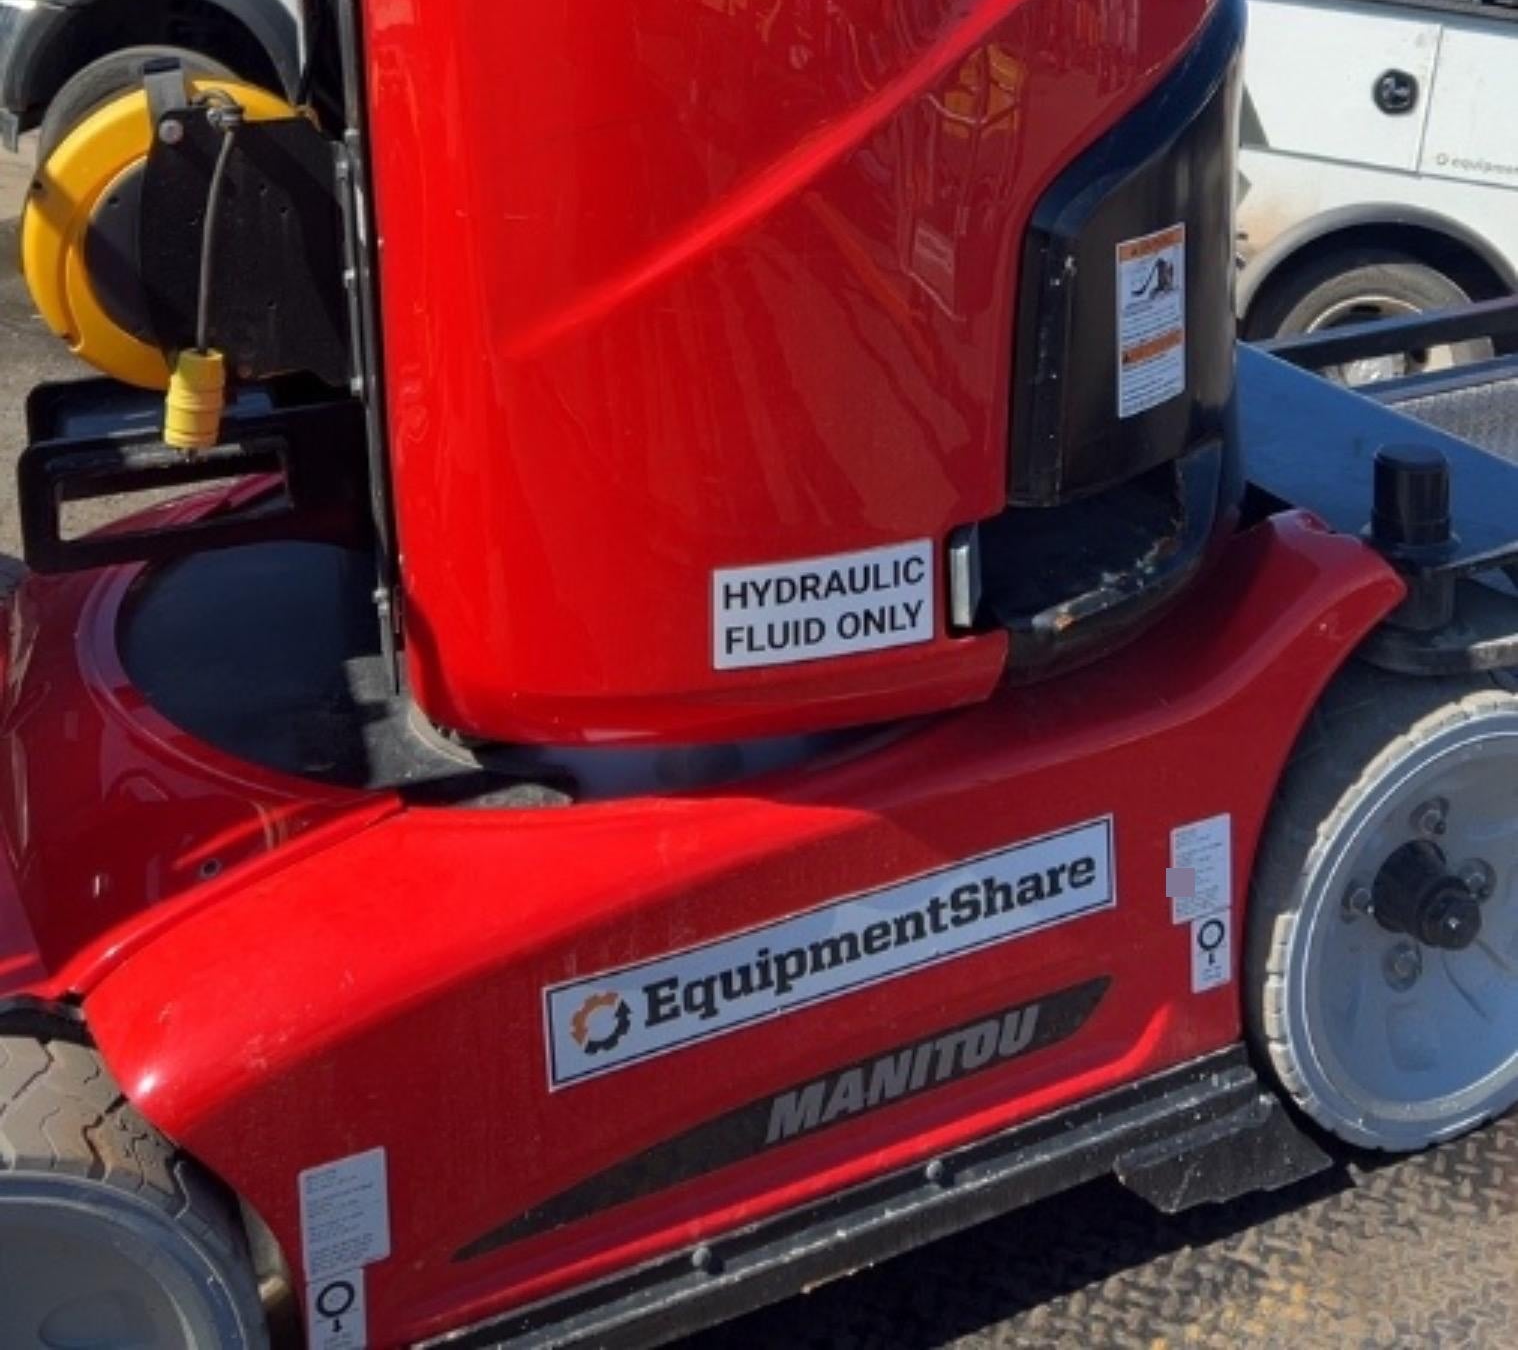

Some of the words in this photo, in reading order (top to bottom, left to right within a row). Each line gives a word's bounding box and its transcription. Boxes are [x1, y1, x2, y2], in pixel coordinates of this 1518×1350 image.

[722, 555, 925, 610] HYDRAULIC
[725, 617, 826, 654] FLUID
[836, 600, 924, 640] ONLY
[642, 854, 1096, 1028] EquipmentShare
[764, 1004, 1041, 1145] MANITOU
